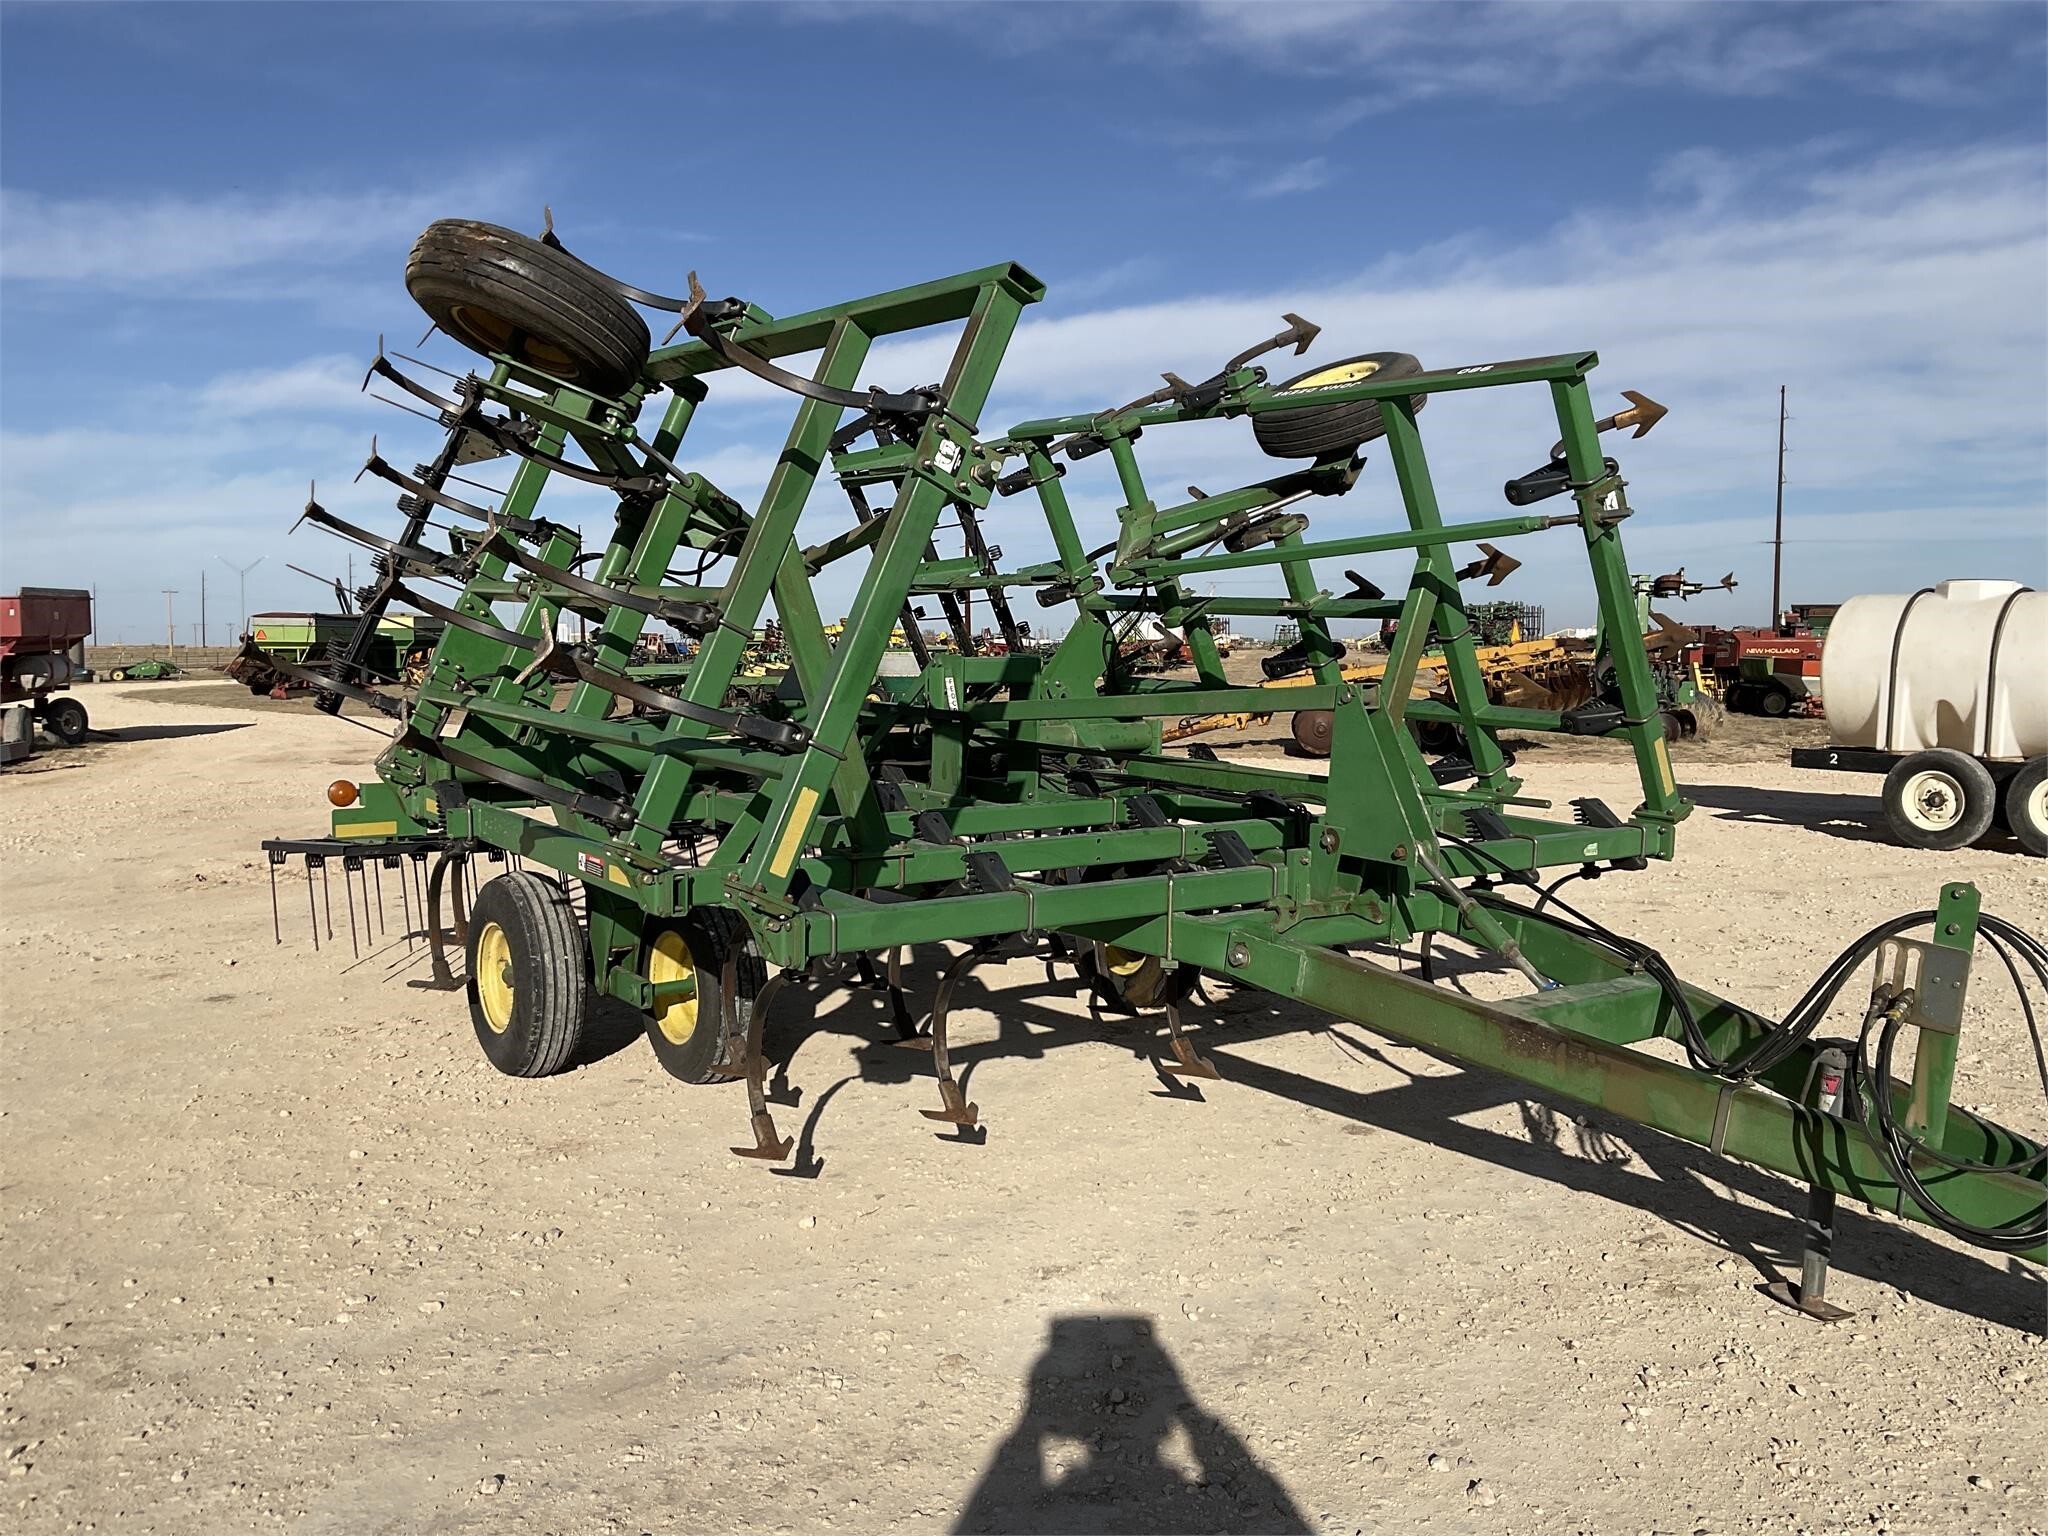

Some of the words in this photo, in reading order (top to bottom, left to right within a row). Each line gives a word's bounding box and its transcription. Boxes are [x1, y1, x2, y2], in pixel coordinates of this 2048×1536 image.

[1319, 381, 1362, 392] JOHN
[1271, 387, 1318, 398] DEERE
[1829, 752, 1838, 765] 2
